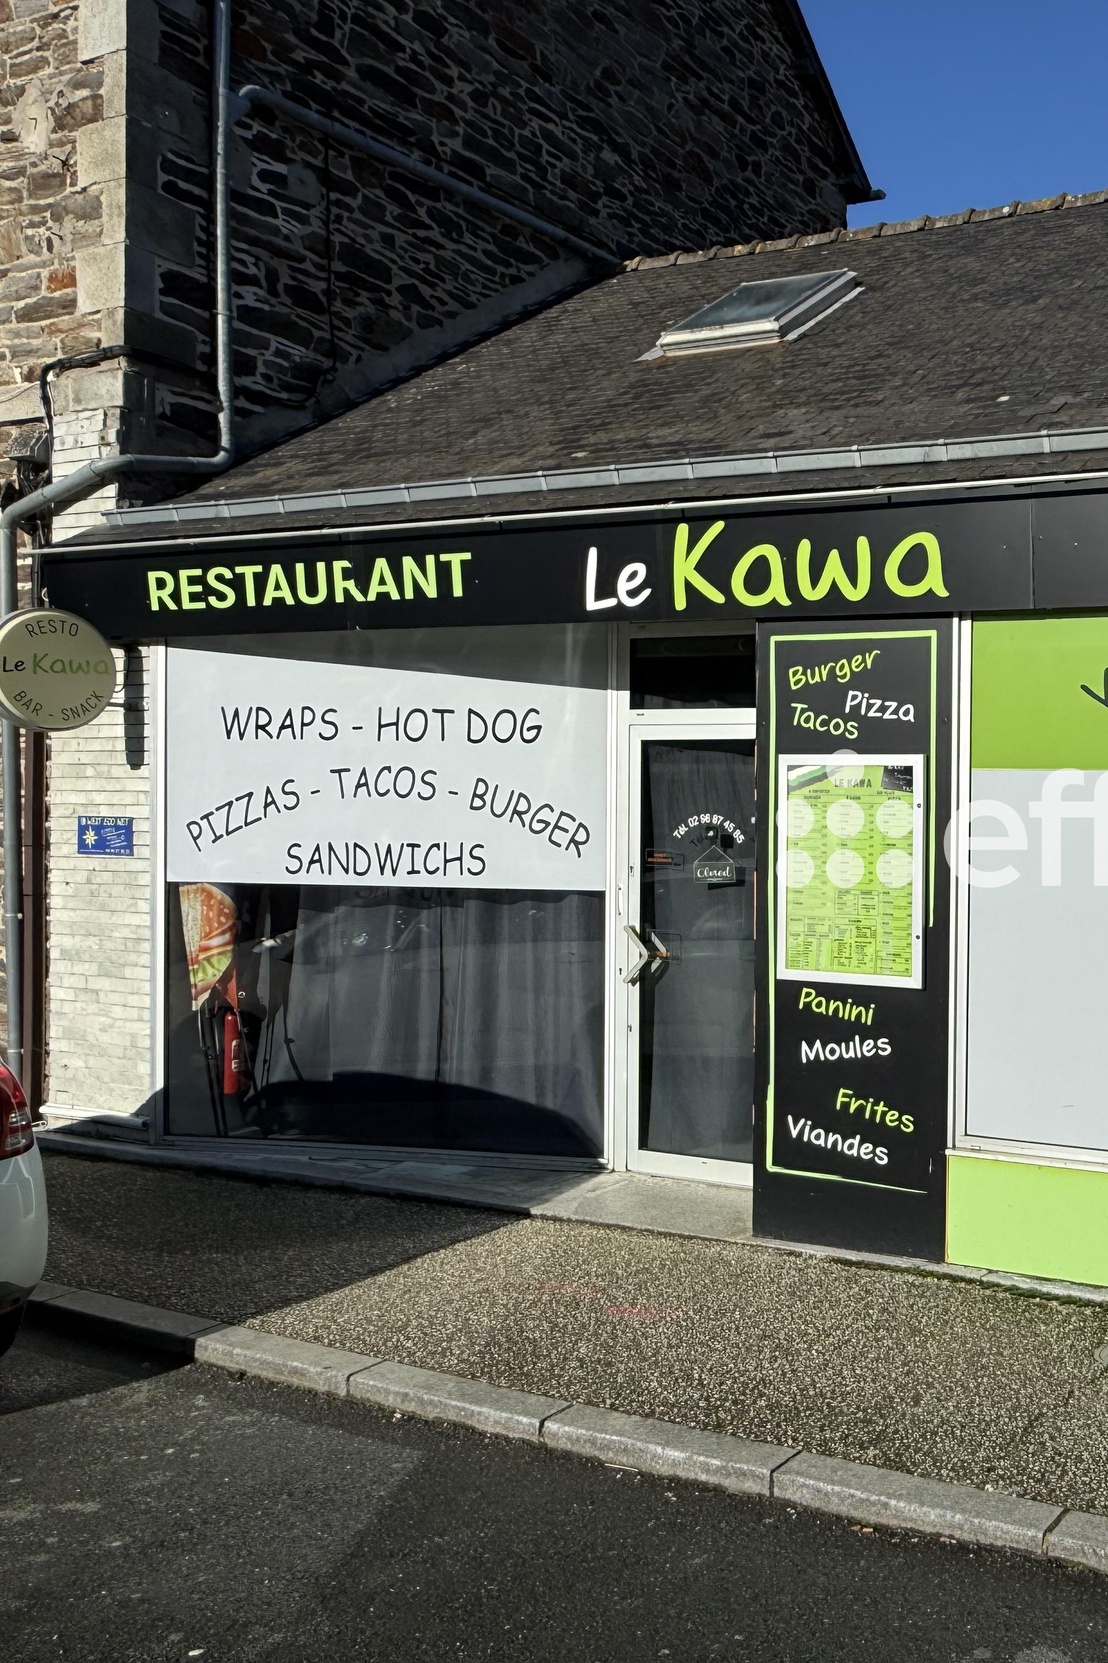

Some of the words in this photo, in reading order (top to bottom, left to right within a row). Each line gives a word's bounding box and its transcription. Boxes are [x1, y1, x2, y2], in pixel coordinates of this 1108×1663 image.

[147, 552, 472, 611] RESTAURANT
[585, 546, 652, 611] Le
[673, 520, 950, 611] Kawa
[25, 619, 79, 637] RESTO
[2, 656, 26, 673] Le
[32, 653, 110, 675] Kawa
[788, 649, 880, 690] Burger
[13, 690, 43, 716] BAR
[61, 690, 104, 721] SNACK
[790, 703, 859, 739] Tacos
[845, 690, 915, 722] Pizza
[221, 706, 339, 741] WRAPS
[377, 706, 455, 743] HOT
[466, 708, 543, 743] DOG
[186, 779, 300, 852] PIZZAS
[330, 766, 437, 800] TACOS
[469, 778, 590, 858] BURGER
[688, 815, 700, 828] 02
[712, 814, 724, 826] 87
[723, 820, 736, 833] 45
[285, 842, 486, 876] SANDWICHS
[696, 866, 731, 878] Closed
[799, 987, 876, 1025] Panini
[801, 1035, 892, 1063] Moules
[836, 1088, 915, 1132] Frites
[787, 1115, 889, 1165] Viandes
